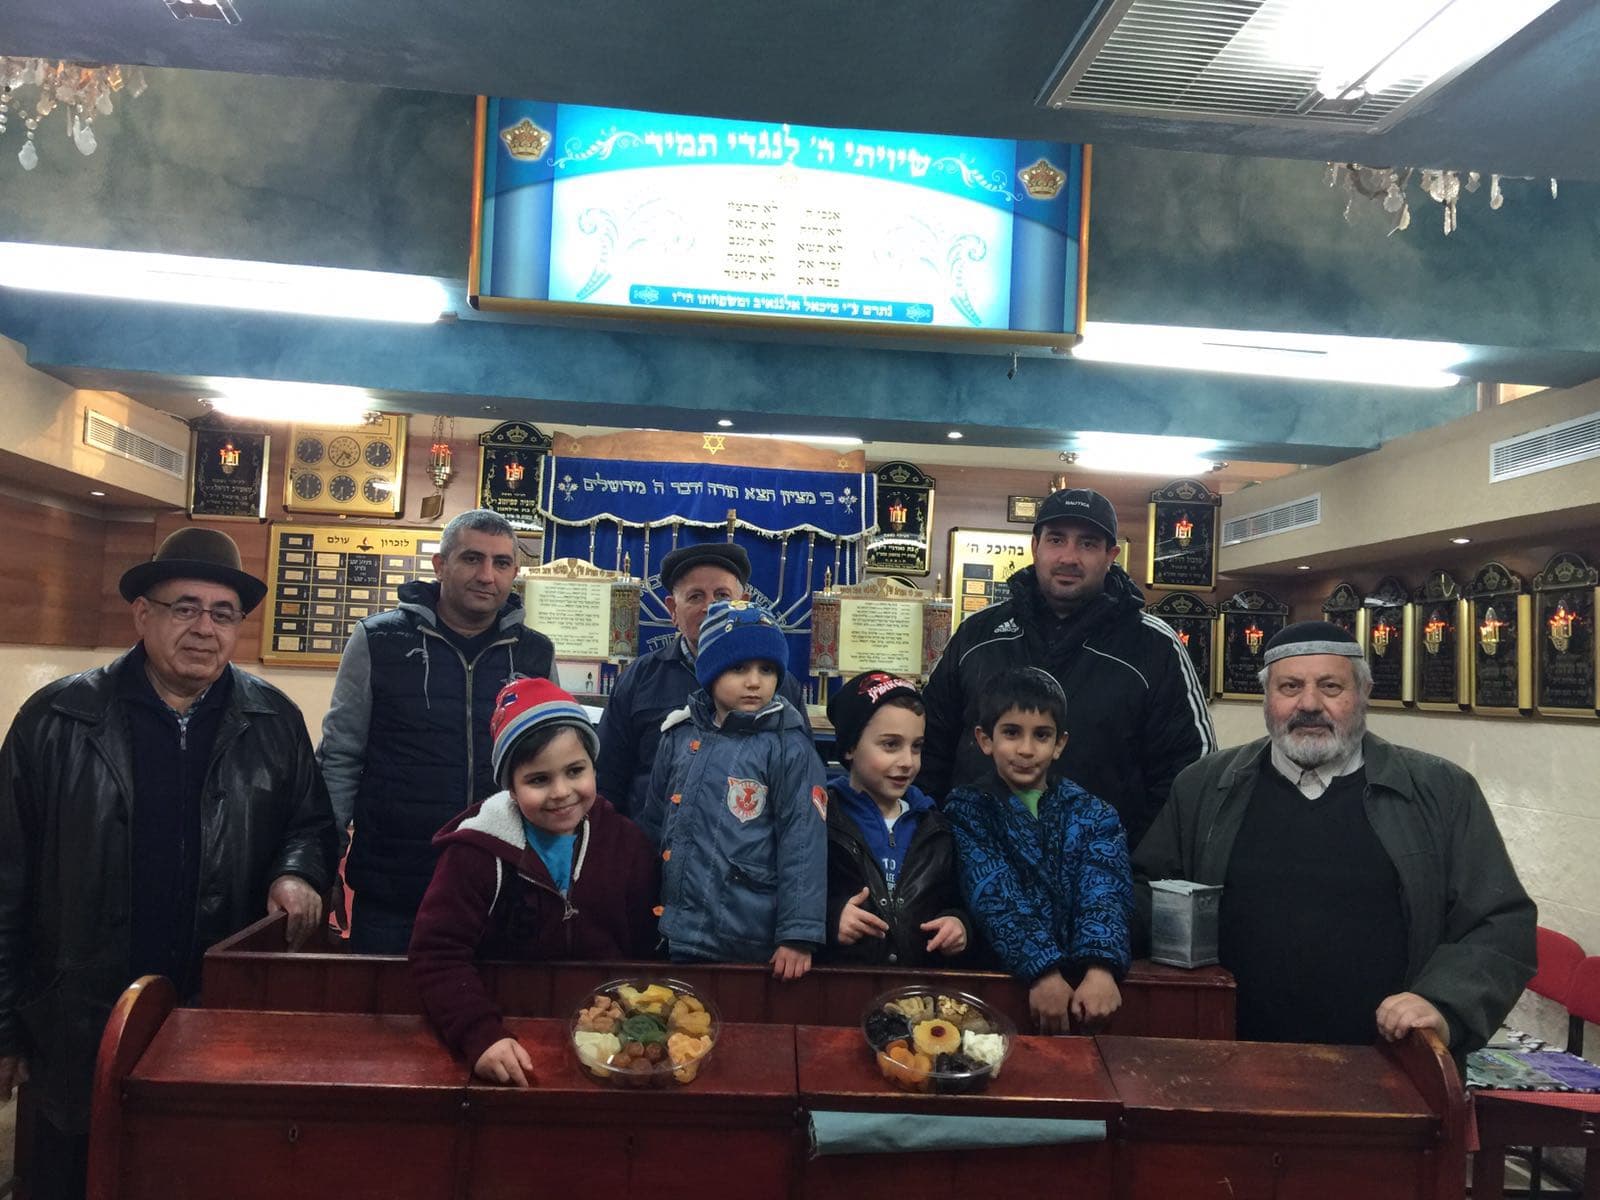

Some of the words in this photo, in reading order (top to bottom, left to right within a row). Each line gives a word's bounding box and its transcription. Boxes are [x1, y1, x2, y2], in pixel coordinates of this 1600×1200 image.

[644, 131, 718, 158] תמיד
[727, 123, 800, 162] לנגדי
[582, 471, 647, 495] מירושלים
[670, 481, 704, 495] ודבר
[707, 482, 739, 499] תורה
[744, 487, 776, 502] תצא
[780, 490, 817, 506] מציון
[819, 491, 835, 505] כי
[327, 534, 350, 545] עולם
[380, 537, 410, 548] לזכרון
[986, 543, 1024, 556] בהיכל
